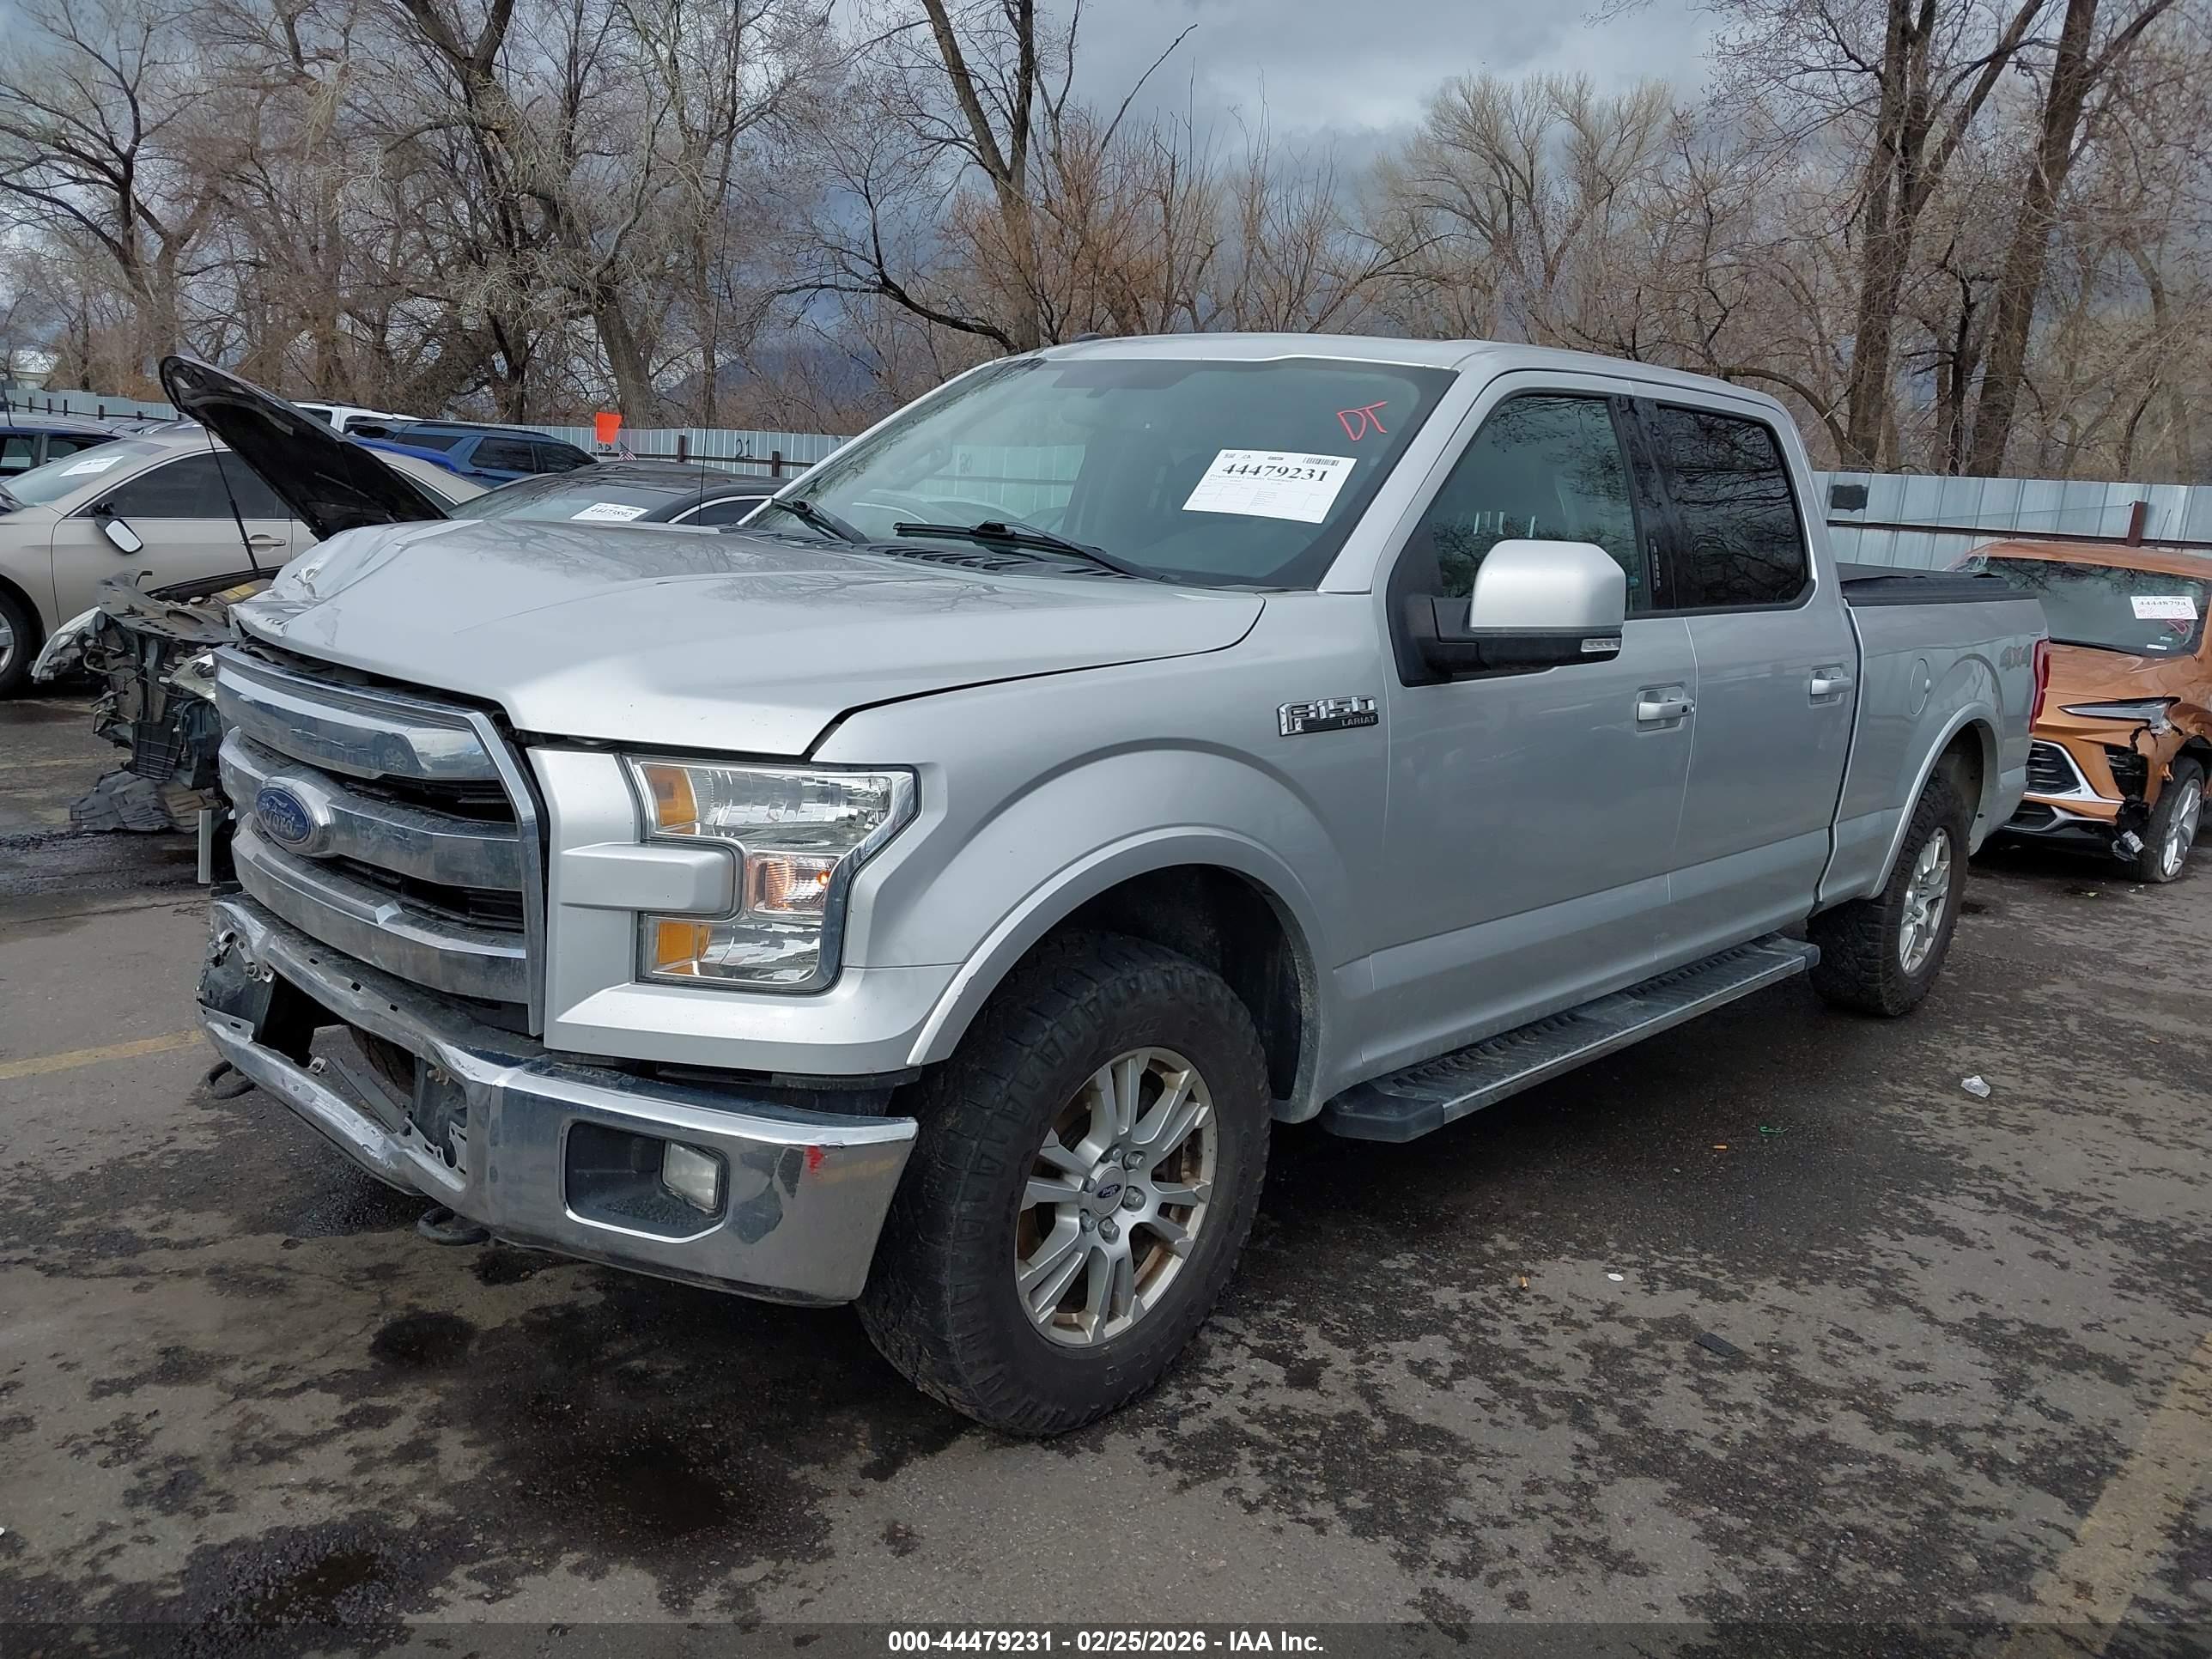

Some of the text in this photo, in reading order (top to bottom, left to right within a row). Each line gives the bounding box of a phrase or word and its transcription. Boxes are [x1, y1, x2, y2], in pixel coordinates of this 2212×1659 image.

[1336, 400, 1389, 441] DT
[735, 437, 754, 459] 21
[1222, 463, 1328, 482] 44479231
[1341, 715, 1375, 726] LARIAT
